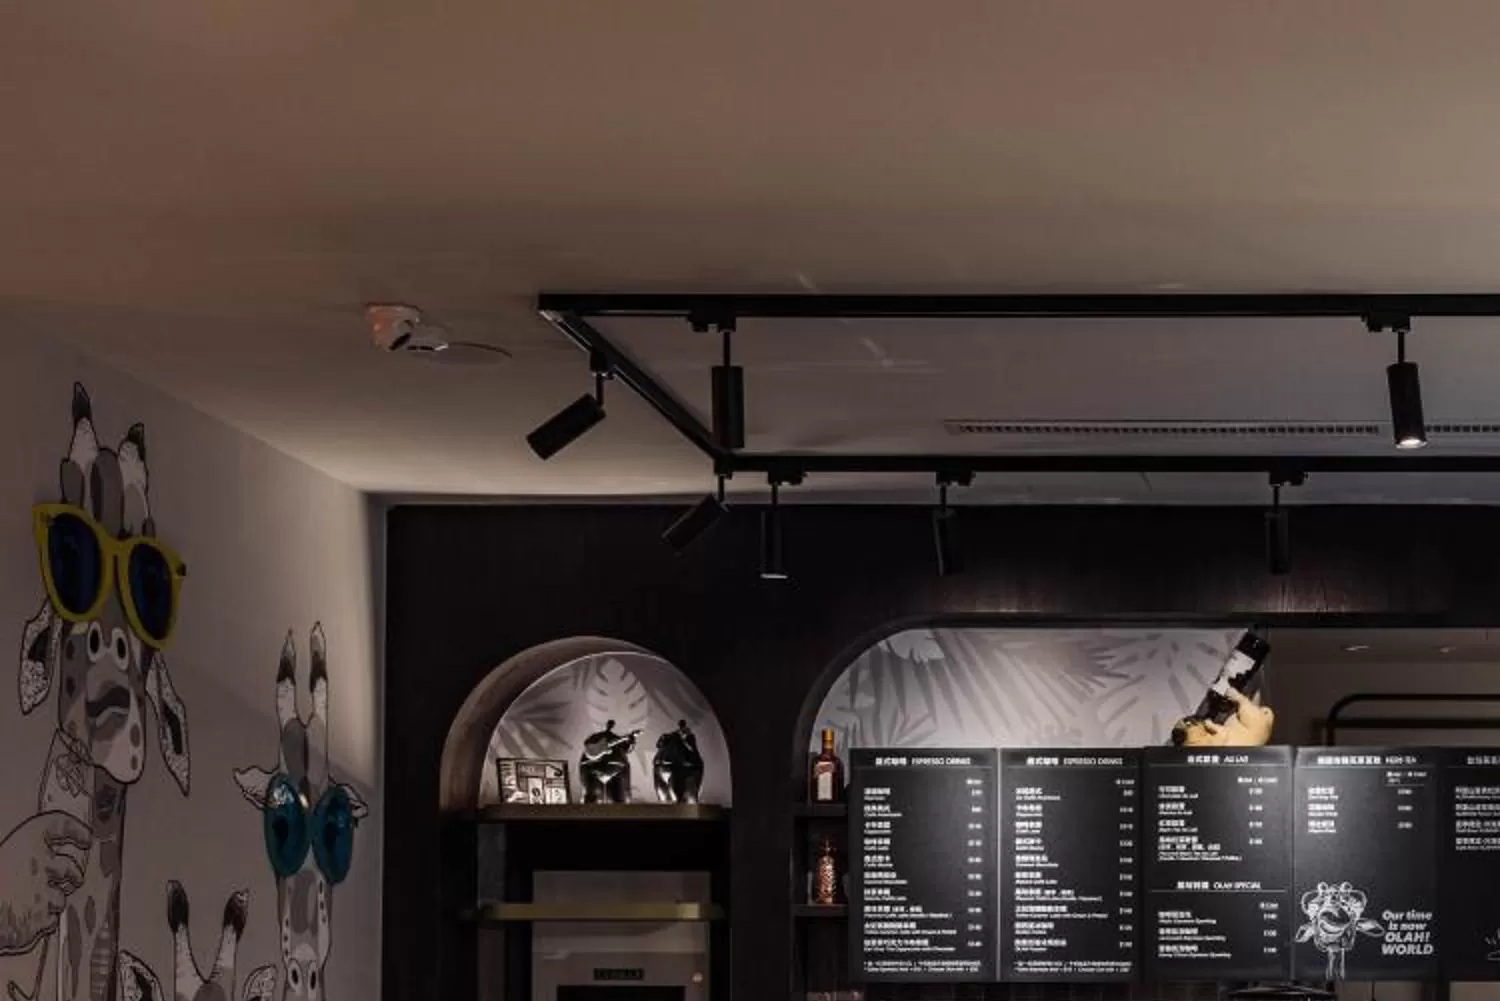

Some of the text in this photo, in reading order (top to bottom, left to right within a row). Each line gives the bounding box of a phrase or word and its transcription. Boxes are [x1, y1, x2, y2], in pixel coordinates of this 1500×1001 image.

[1382, 909, 1433, 921] Our time
[1385, 931, 1431, 942] OLAH!
[1381, 943, 1434, 954] WORLD
